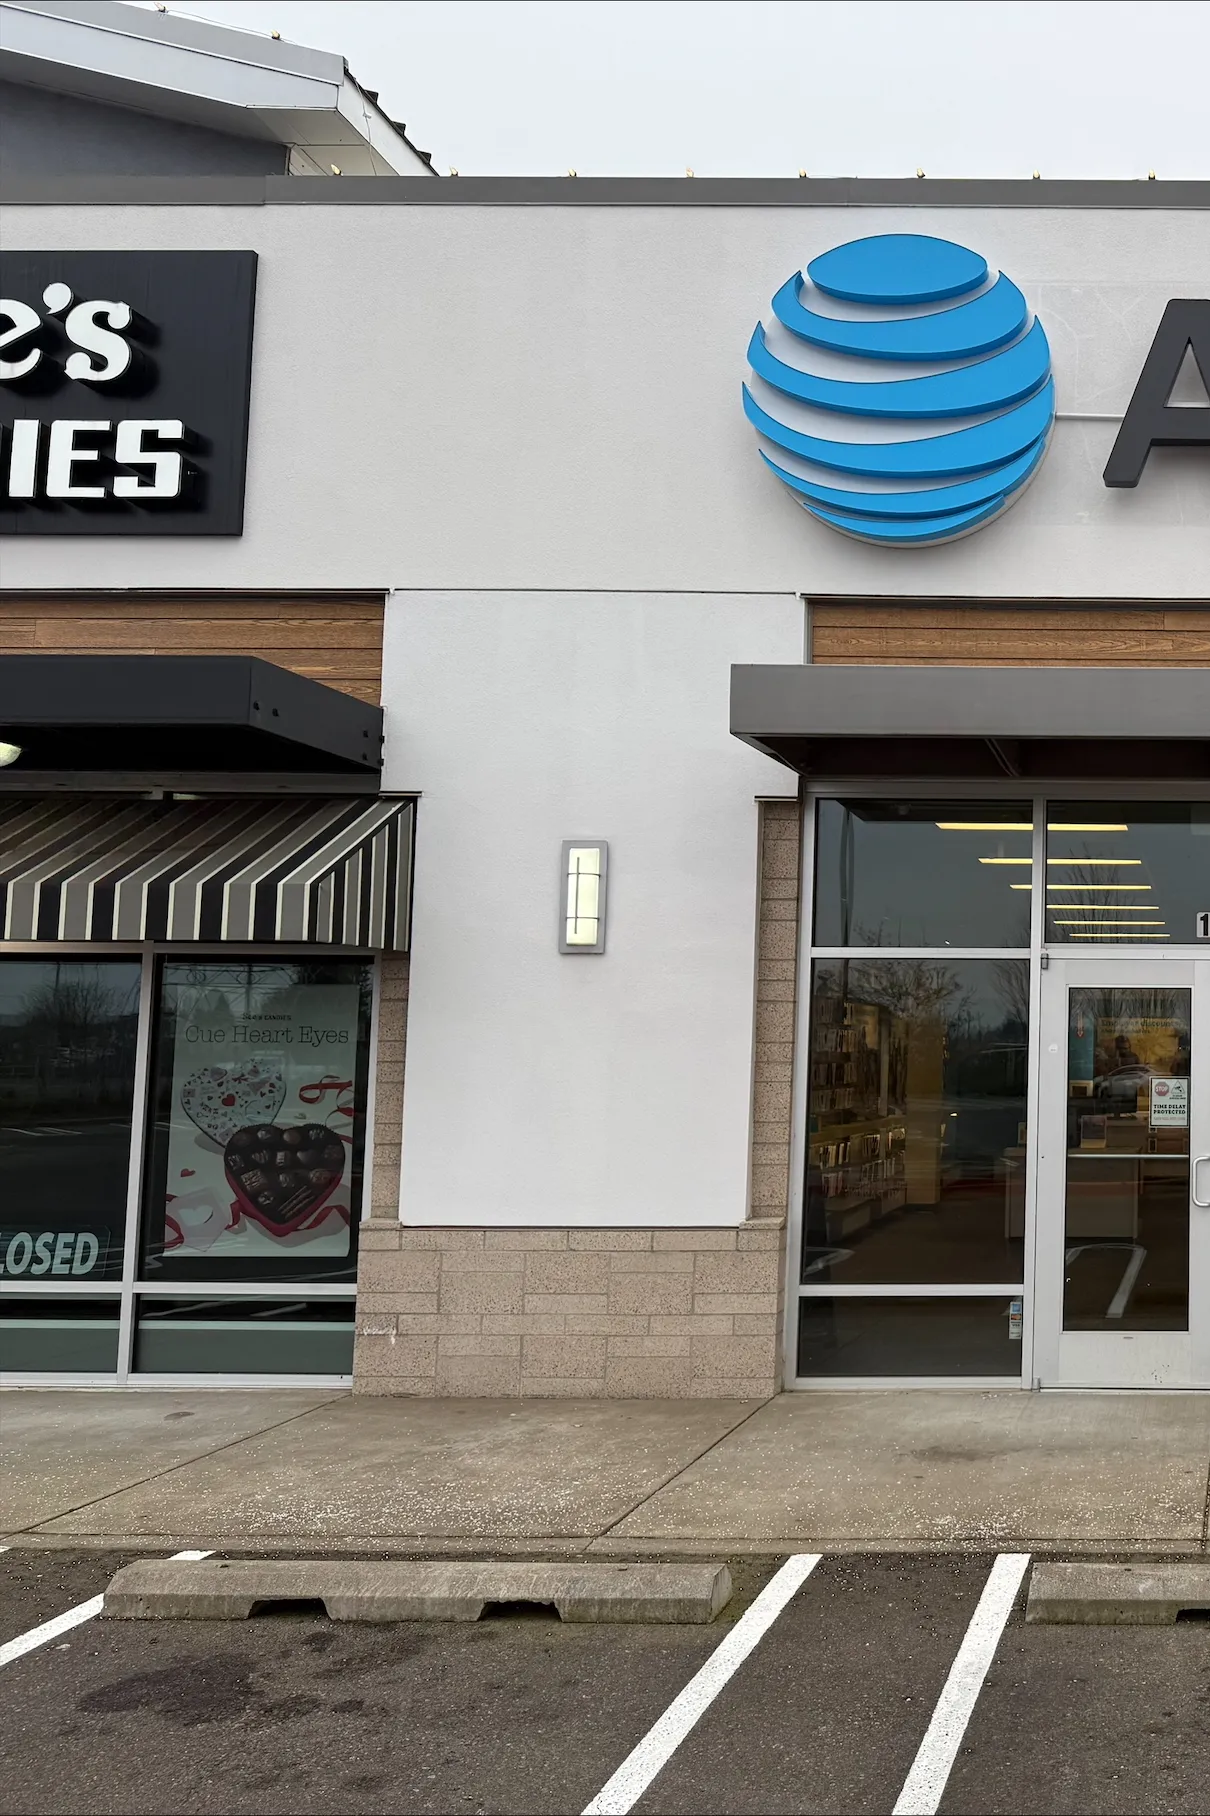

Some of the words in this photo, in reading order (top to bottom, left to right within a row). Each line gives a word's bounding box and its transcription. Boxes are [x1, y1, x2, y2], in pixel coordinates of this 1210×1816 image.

[185, 1025, 226, 1043] Cue
[232, 1026, 293, 1043] Heart
[298, 1026, 349, 1047] Eyes
